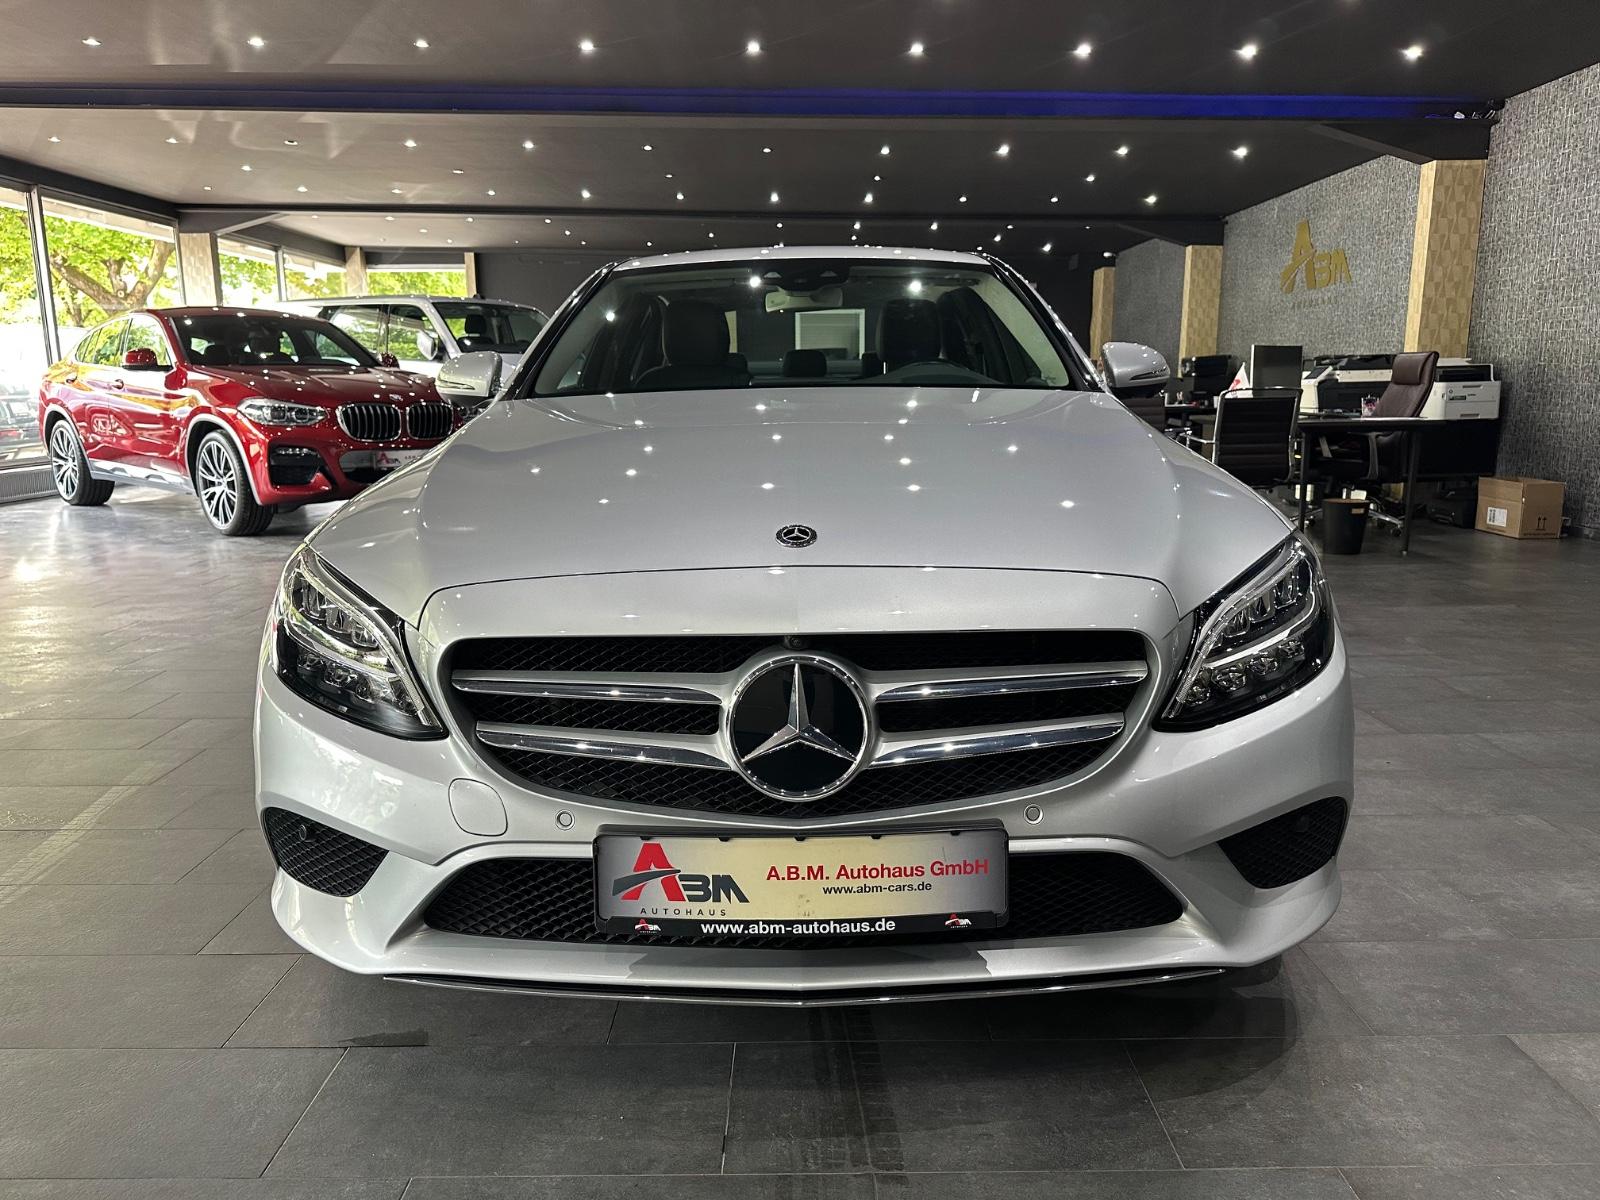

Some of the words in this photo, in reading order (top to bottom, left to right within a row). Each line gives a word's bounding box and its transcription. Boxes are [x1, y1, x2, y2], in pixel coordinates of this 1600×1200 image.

[1278, 217, 1352, 294] ABM
[612, 842, 750, 904] ABM
[766, 865, 830, 881] A.B.M.
[836, 861, 925, 880] Autohaus
[930, 858, 990, 876] GmbH
[822, 881, 932, 895] www.abm-cars.de
[640, 907, 726, 917] AUTOHAUS
[701, 919, 896, 935] www.abm-autohaus.de
